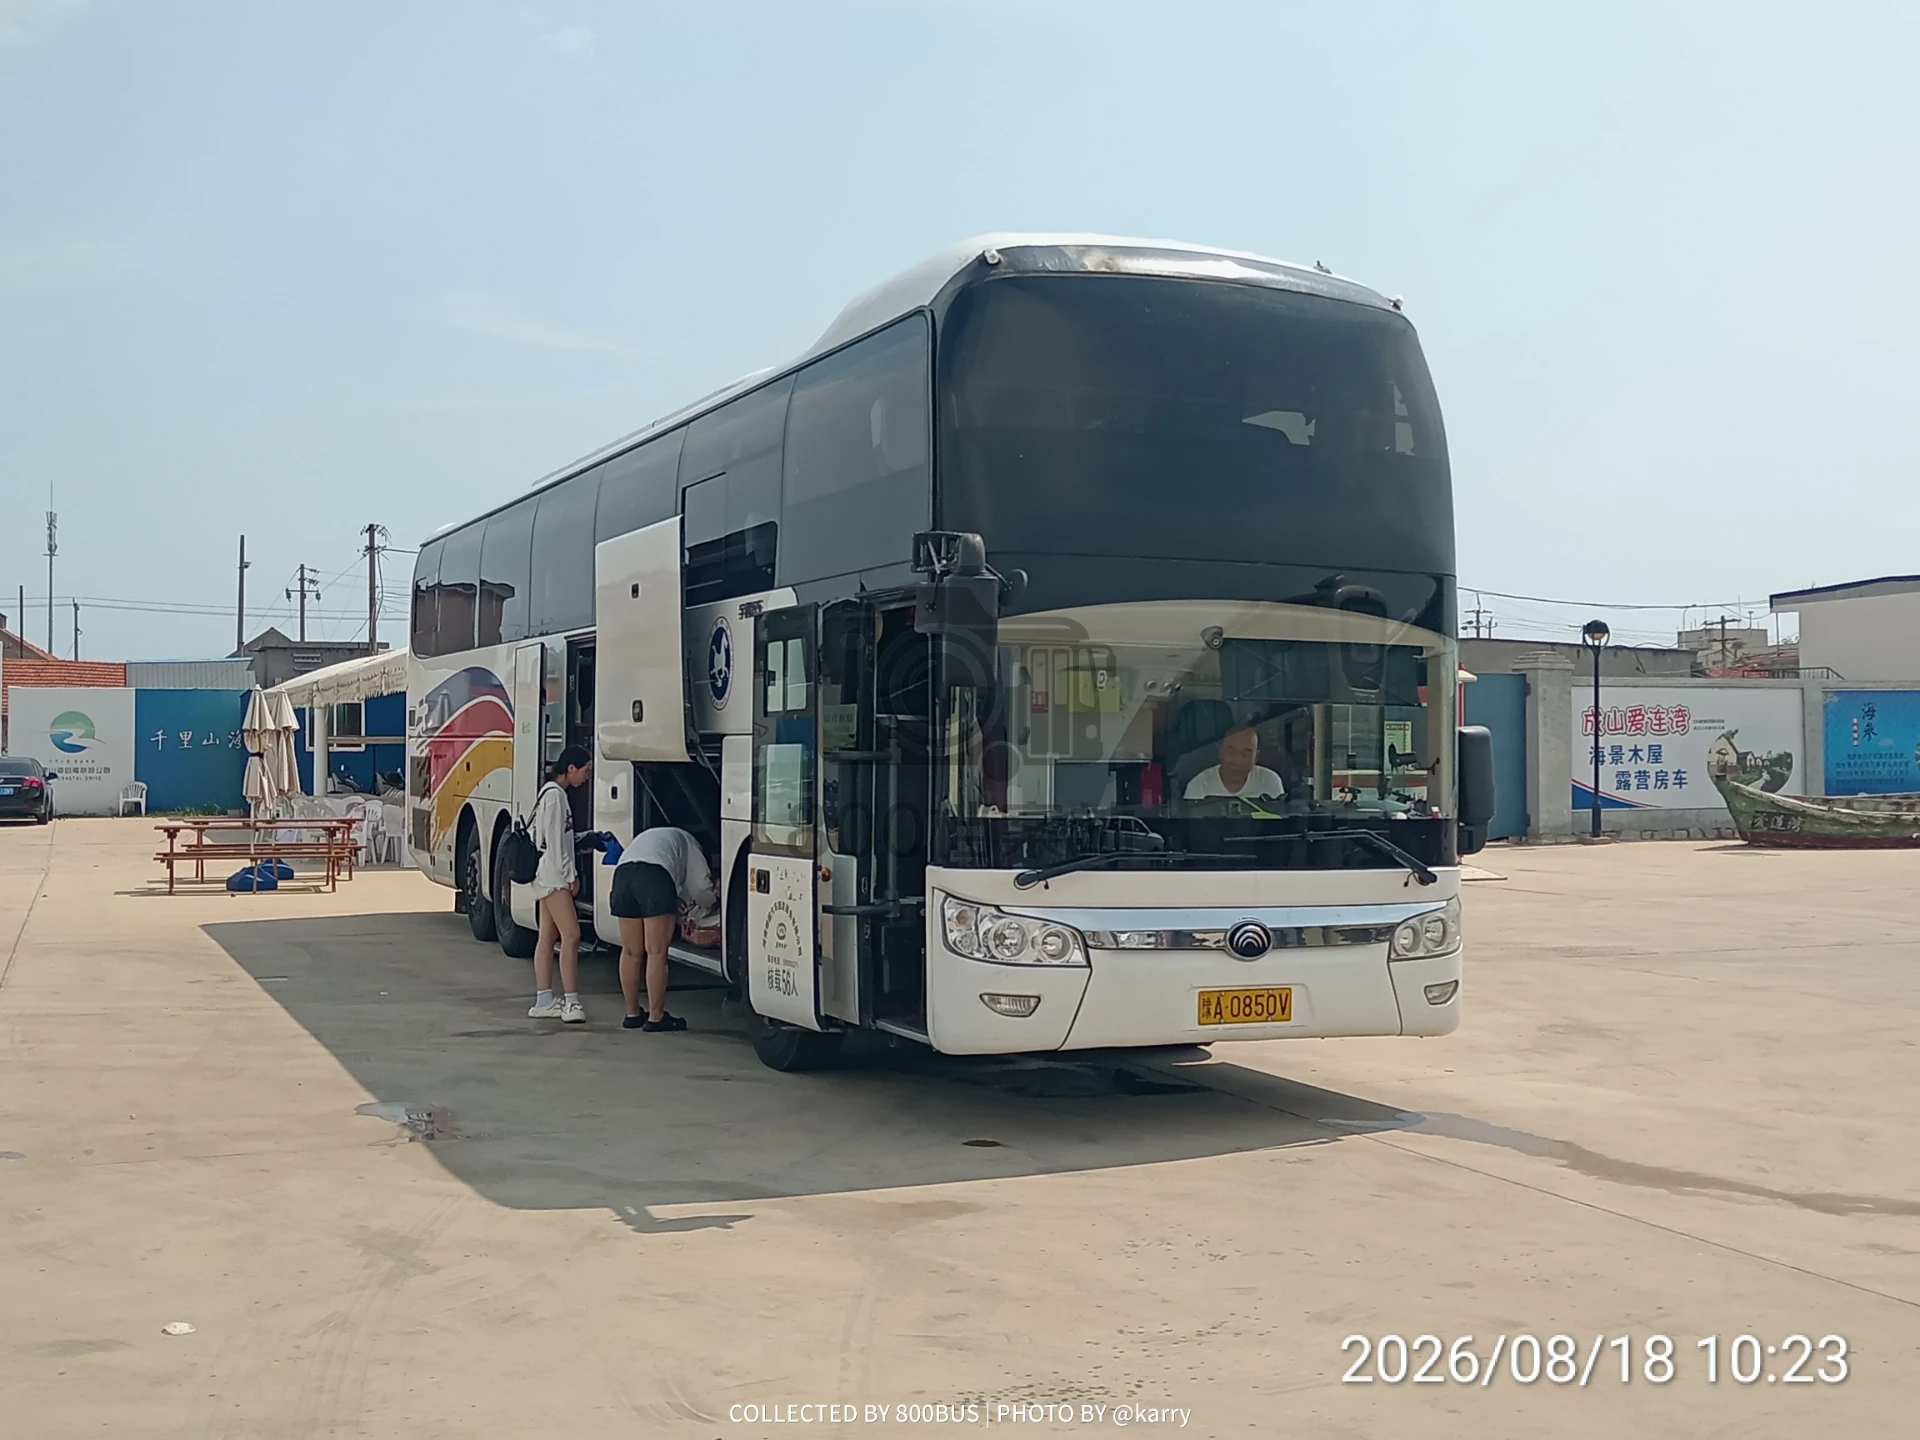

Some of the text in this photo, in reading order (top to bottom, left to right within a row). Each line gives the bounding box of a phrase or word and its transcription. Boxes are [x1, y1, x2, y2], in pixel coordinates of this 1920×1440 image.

[1583, 705, 1689, 735] 成山爱连湾
[1588, 744, 1664, 766] 海景木屋
[1615, 769, 1688, 791] 露营房车
